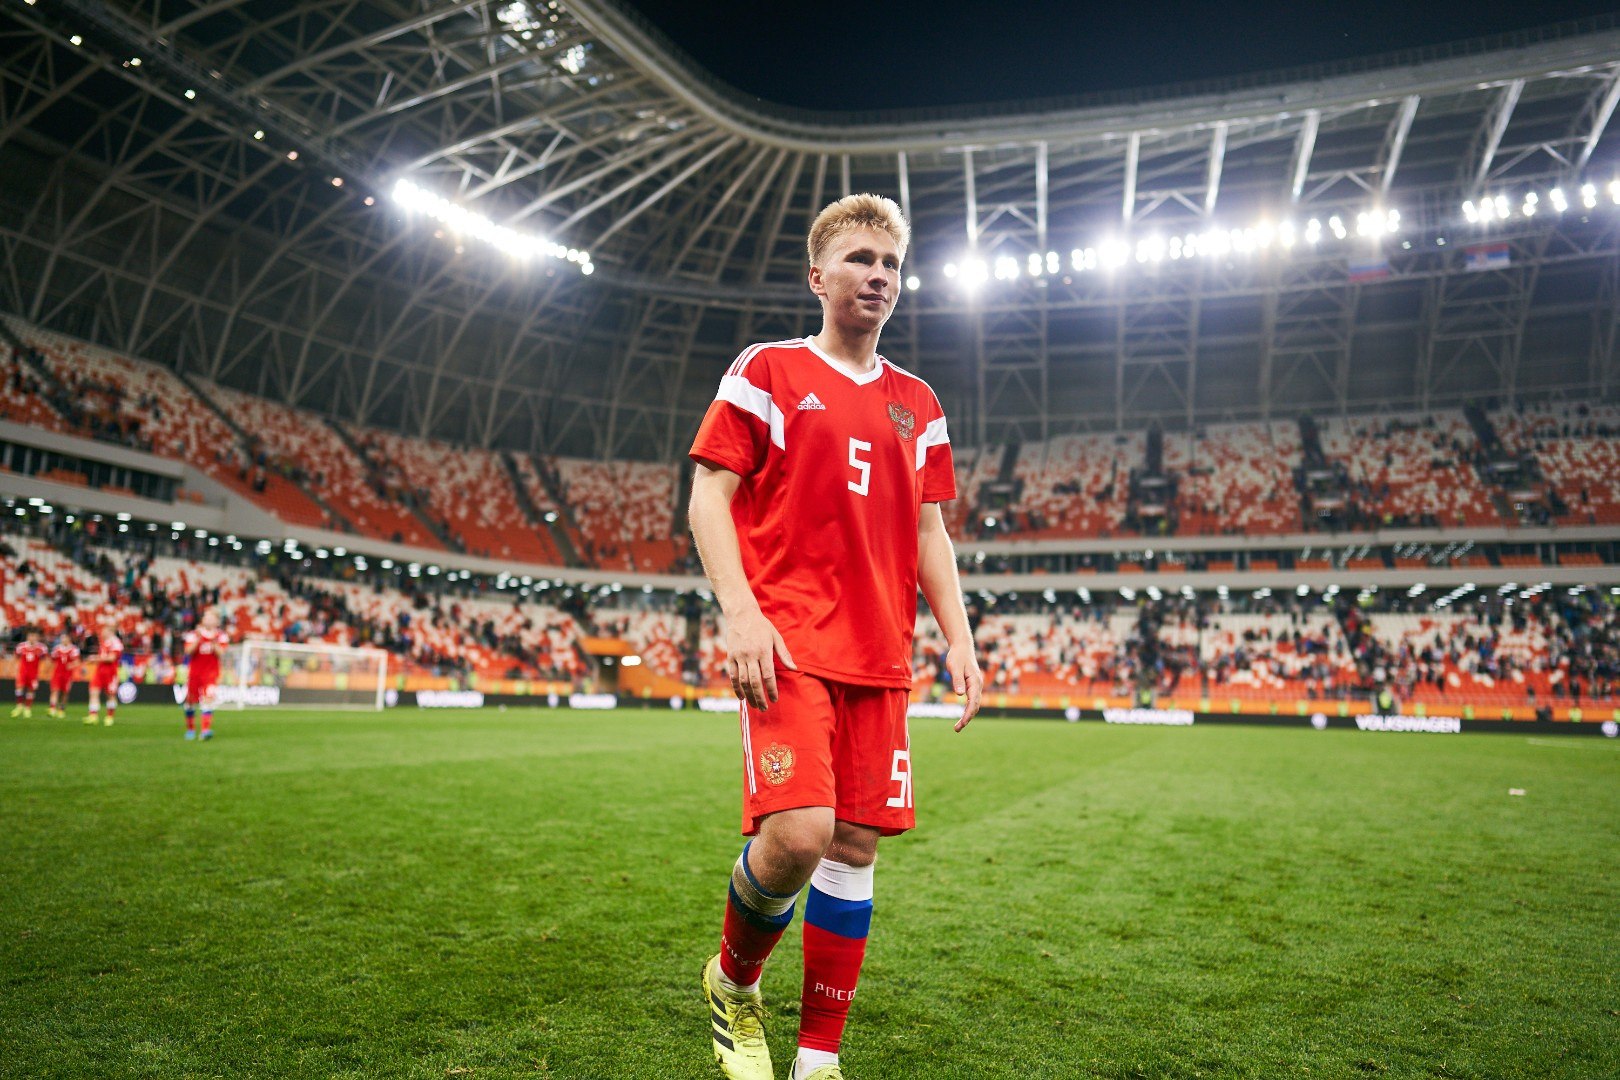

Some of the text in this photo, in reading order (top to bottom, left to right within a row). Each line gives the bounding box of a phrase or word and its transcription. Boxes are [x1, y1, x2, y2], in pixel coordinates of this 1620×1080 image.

[797, 403, 827, 411] adidas
[847, 436, 871, 497] 5
[1354, 714, 1461, 734] VOLKSWAGEN
